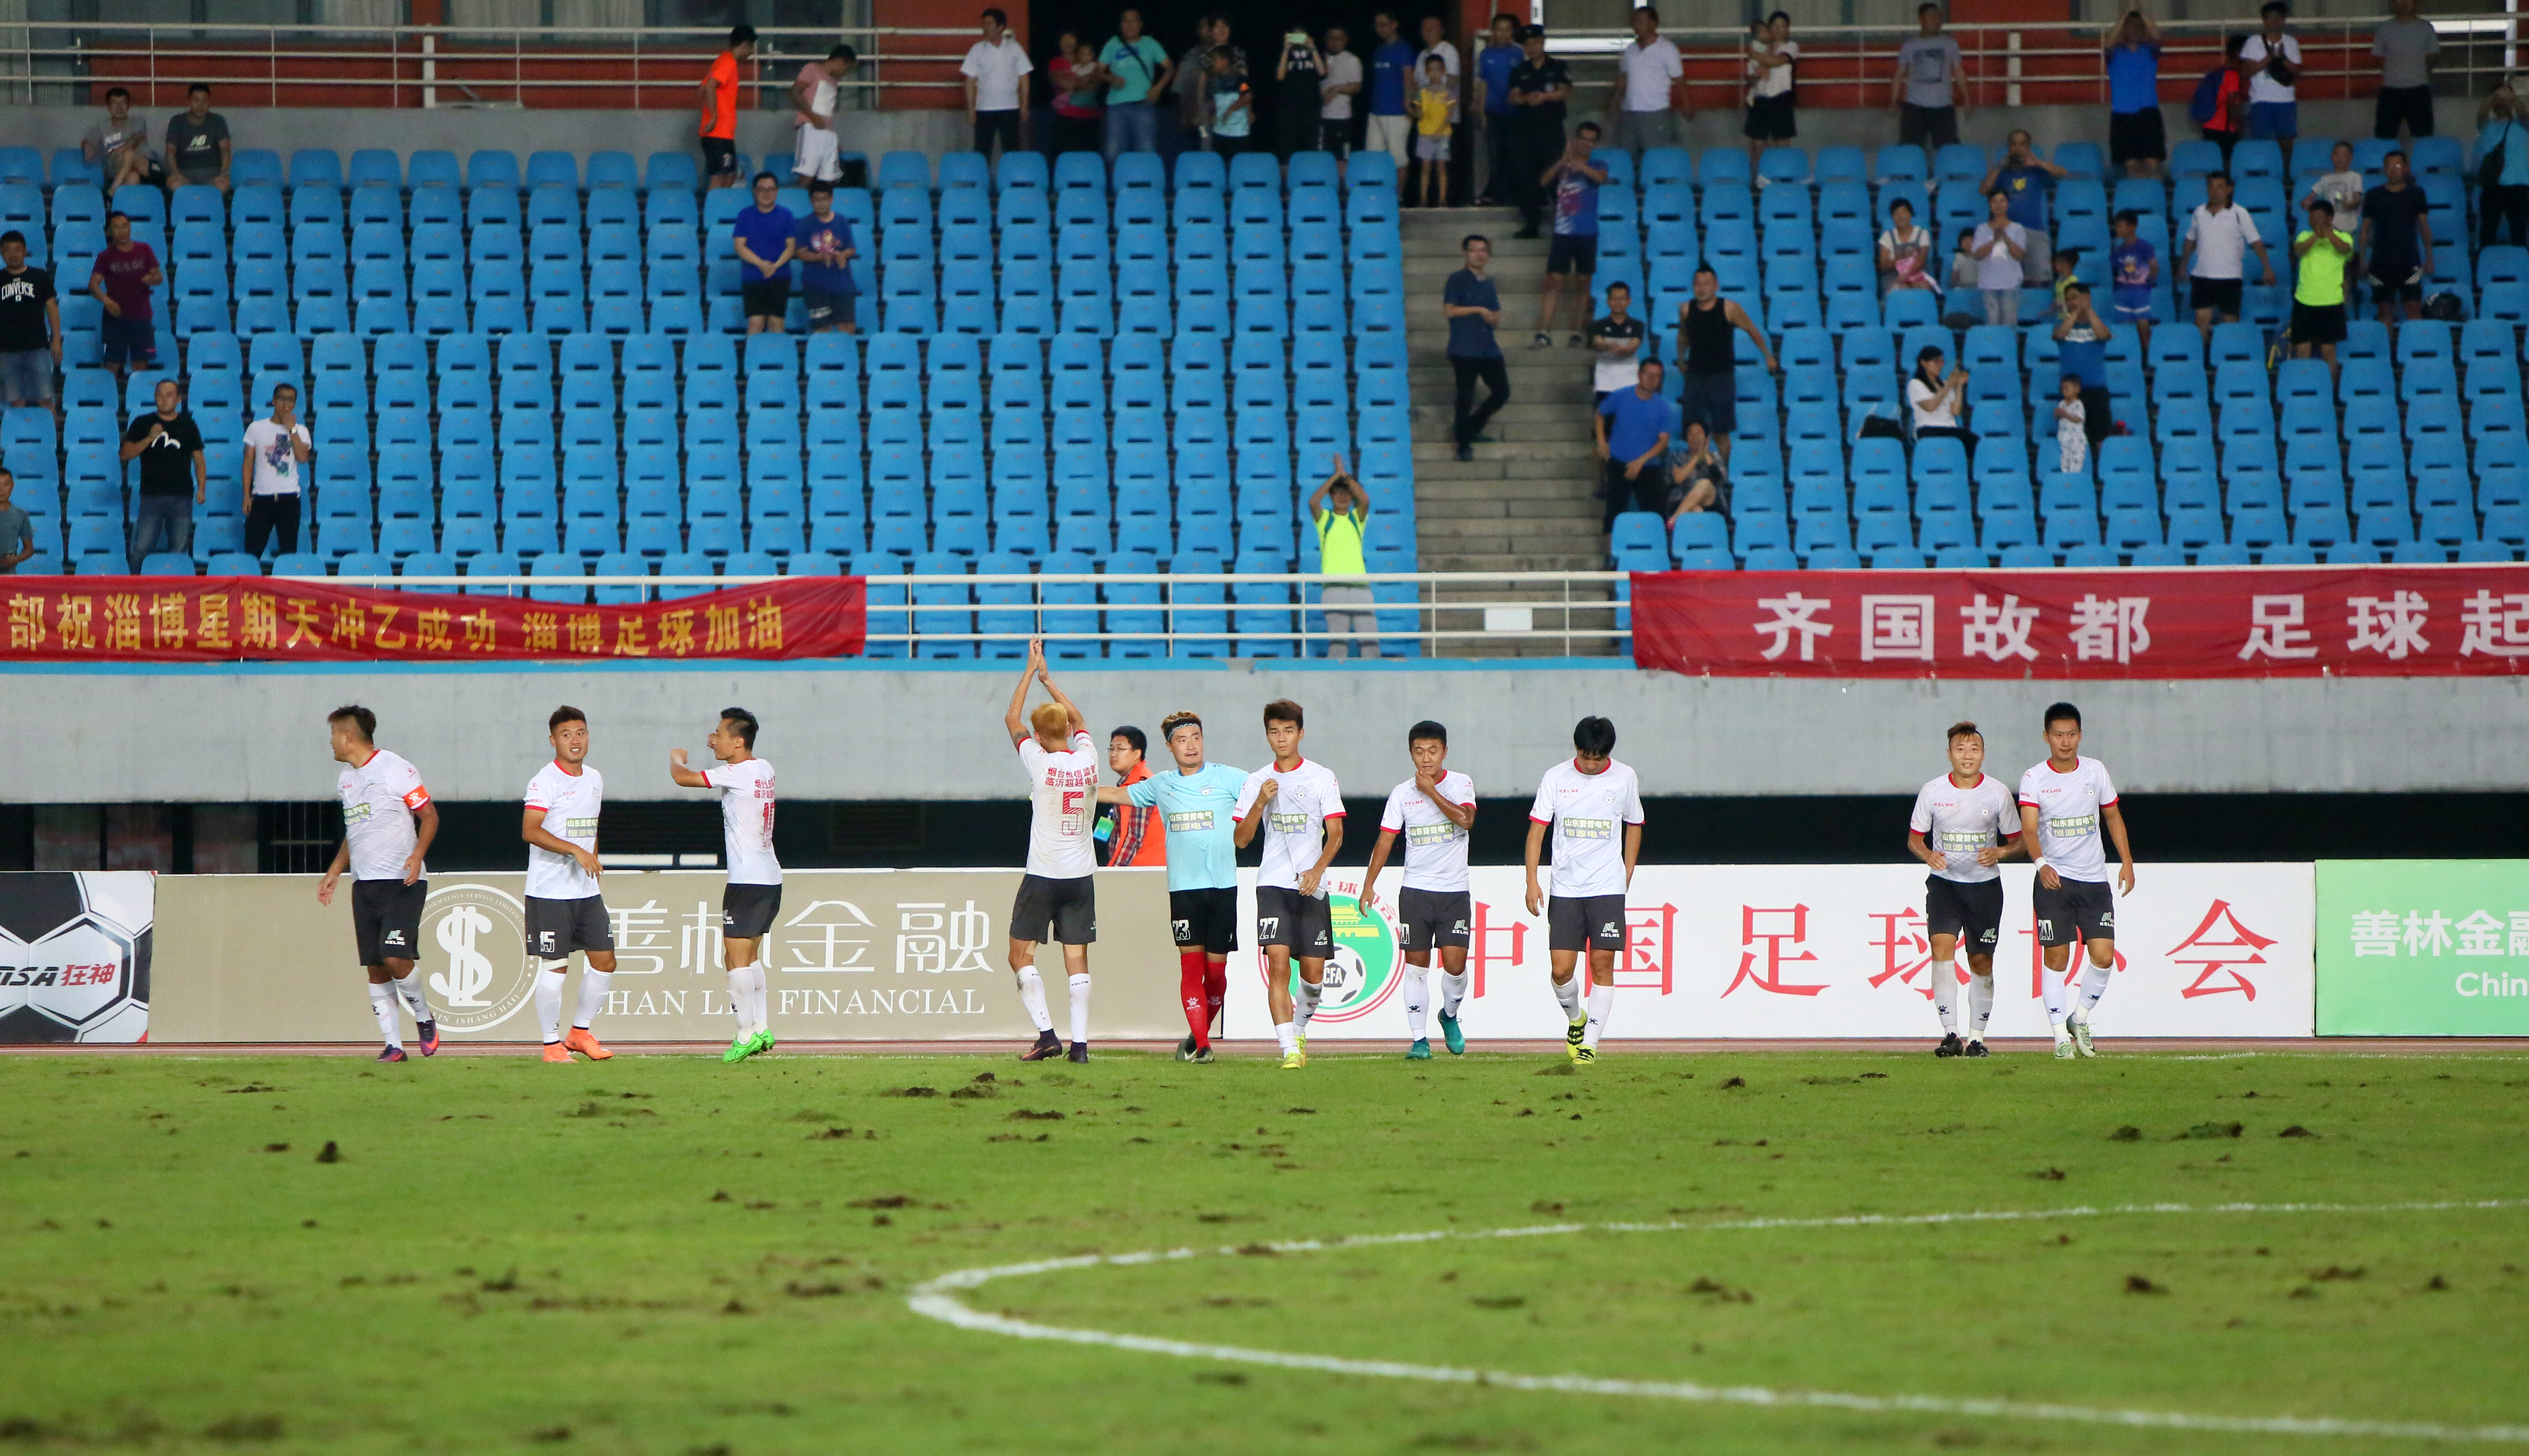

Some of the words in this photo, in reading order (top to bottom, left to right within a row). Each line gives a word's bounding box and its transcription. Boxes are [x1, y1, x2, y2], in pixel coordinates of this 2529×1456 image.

[2, 281, 35, 300] CONVERSE
[8, 592, 496, 651] 部祝淄博星期天冲乙成功
[521, 595, 783, 657] 淄博足球加油
[1753, 591, 2151, 664] 齐国故都
[2237, 589, 2529, 660] 足球起
[567, 819, 598, 827] 山东爱普电
[1062, 791, 1084, 835] 5
[1170, 811, 1212, 822] 山东爱普电气
[1171, 821, 1213, 832] 恒源电气
[1411, 824, 1453, 836] 山东爱普电气
[1565, 818, 1610, 829] 山东爱普电气
[1566, 828, 1610, 838] 恒源电气
[1413, 834, 1454, 845] 恒源电气
[1942, 833, 1986, 842] 山东爱普电气
[1172, 919, 1191, 941] 23
[1259, 917, 1279, 940] 27
[2038, 919, 2054, 941] 20
[539, 931, 556, 953] 15
[61, 963, 116, 987] 狂神
[1323, 967, 1343, 984] CFA
[2455, 972, 2528, 997] Chin
[596, 990, 688, 1015] HAN
[778, 989, 985, 1015] FINANCIAL
